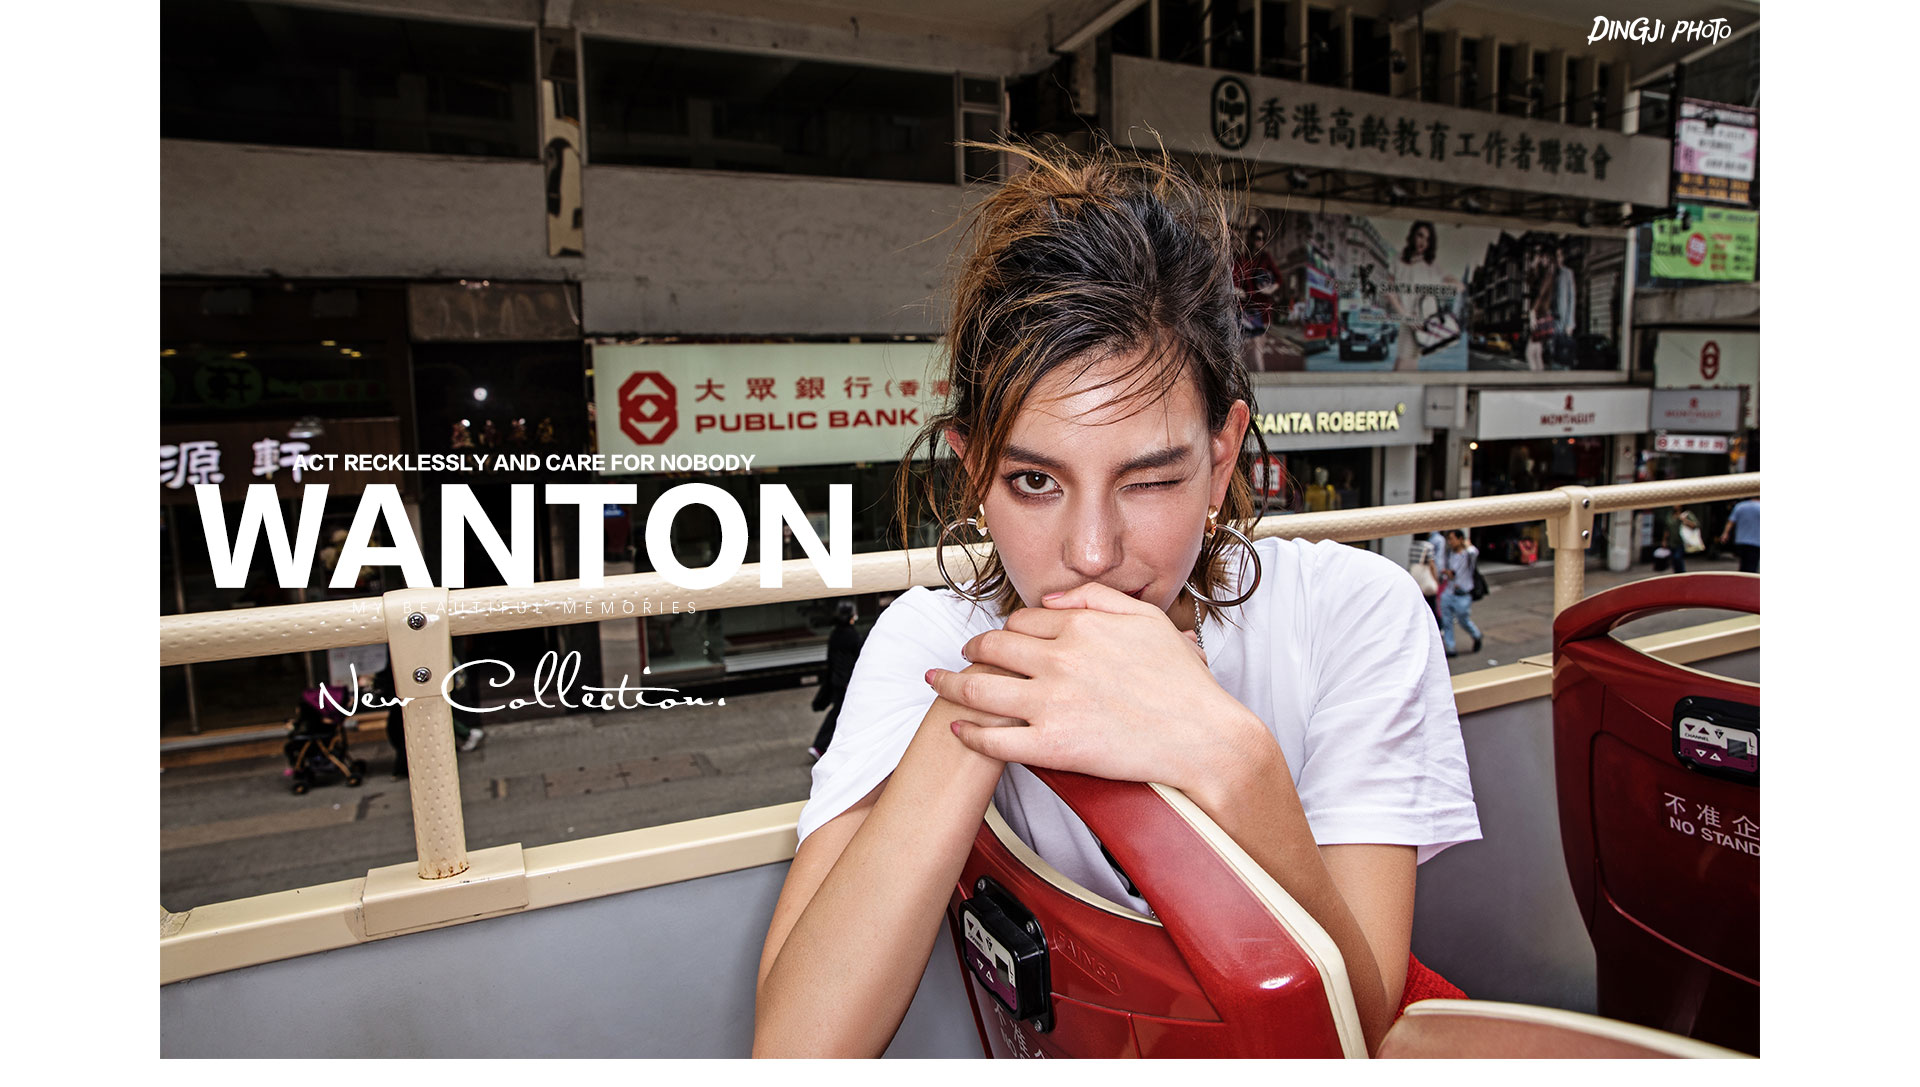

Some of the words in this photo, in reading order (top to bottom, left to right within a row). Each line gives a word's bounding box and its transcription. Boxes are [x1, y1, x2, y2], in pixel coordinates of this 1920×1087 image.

[694, 411, 818, 434] PUBLIC
[827, 407, 919, 430] BANK
[1316, 409, 1400, 432] ROBERTA
[1669, 816, 1695, 836] NO
